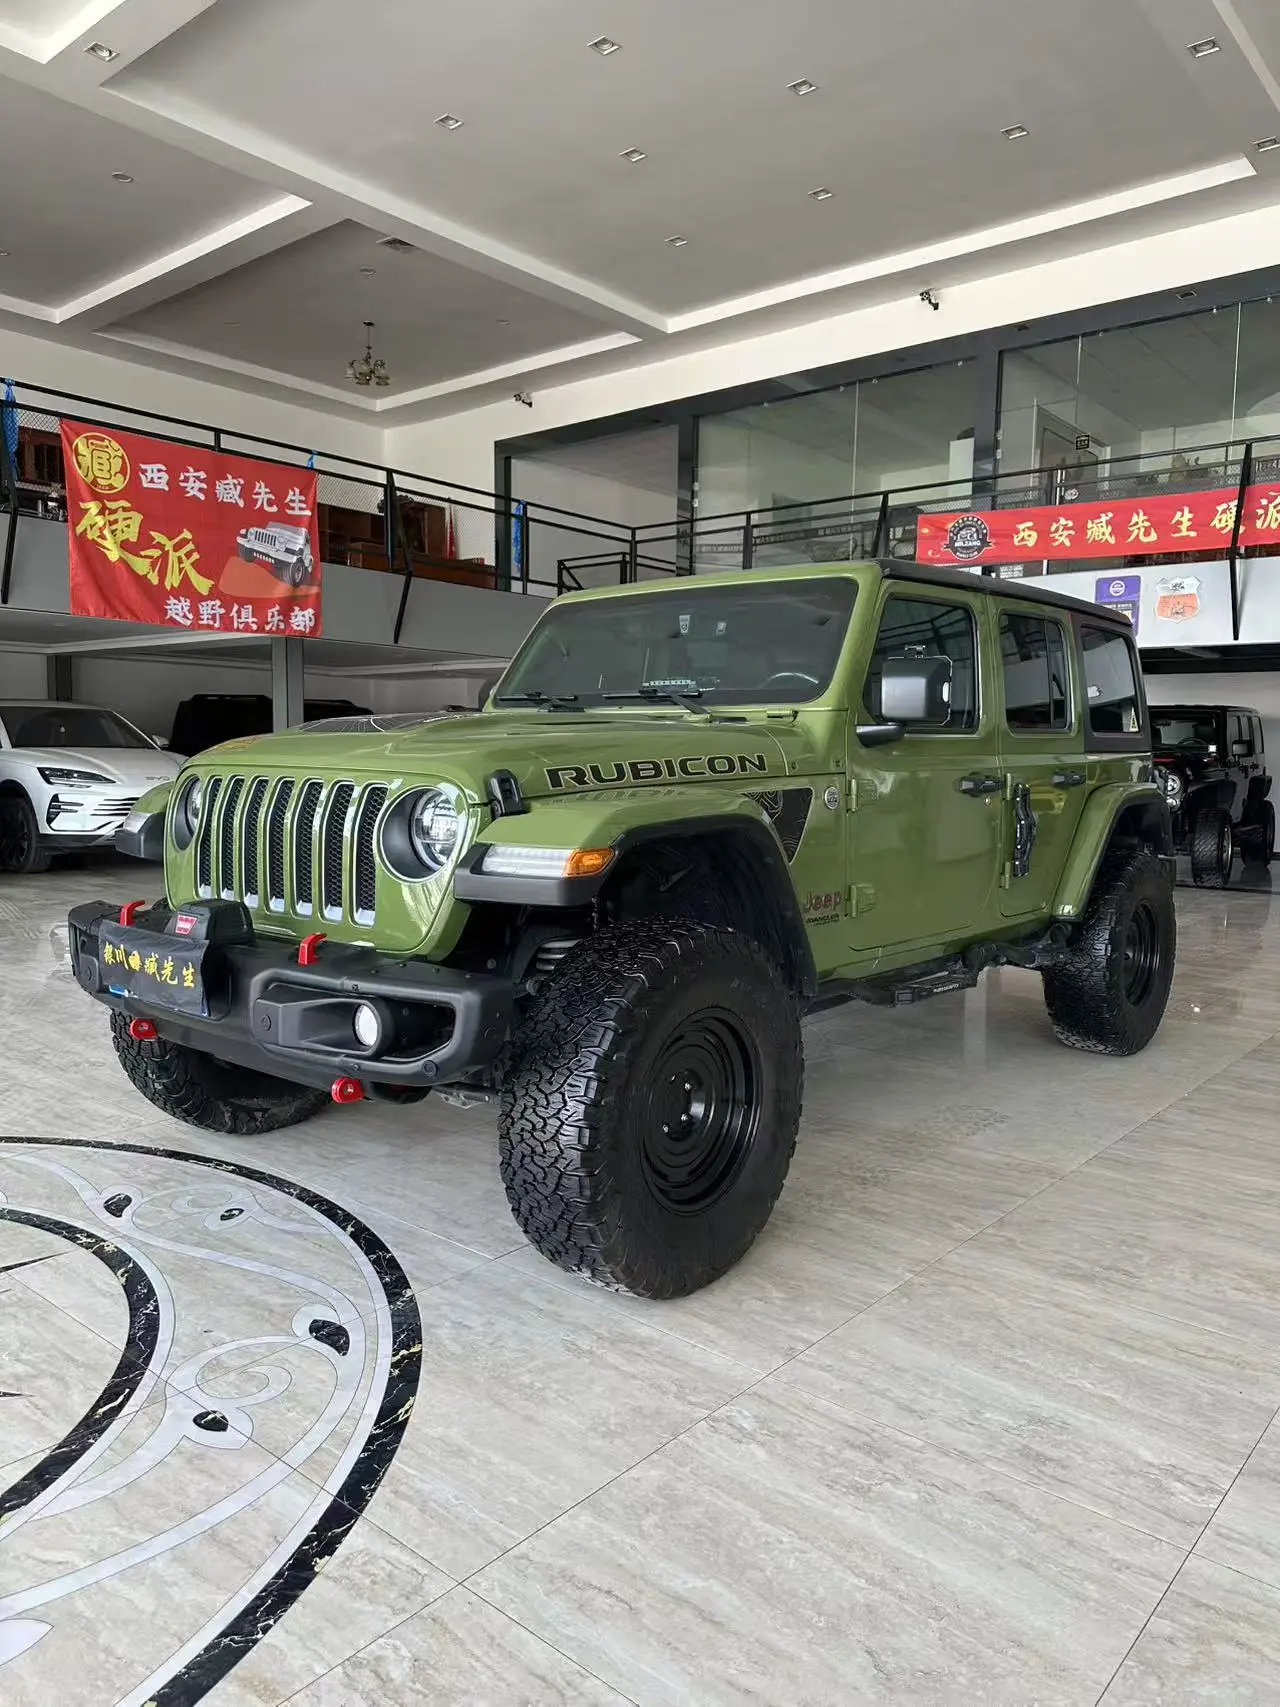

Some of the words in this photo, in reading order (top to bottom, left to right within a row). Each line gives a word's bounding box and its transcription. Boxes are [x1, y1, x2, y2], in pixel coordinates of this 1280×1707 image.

[76, 500, 215, 596] 硬派
[164, 595, 316, 633] 越野俱乐部
[545, 753, 768, 790] RUBICON
[803, 890, 842, 913] Jeep
